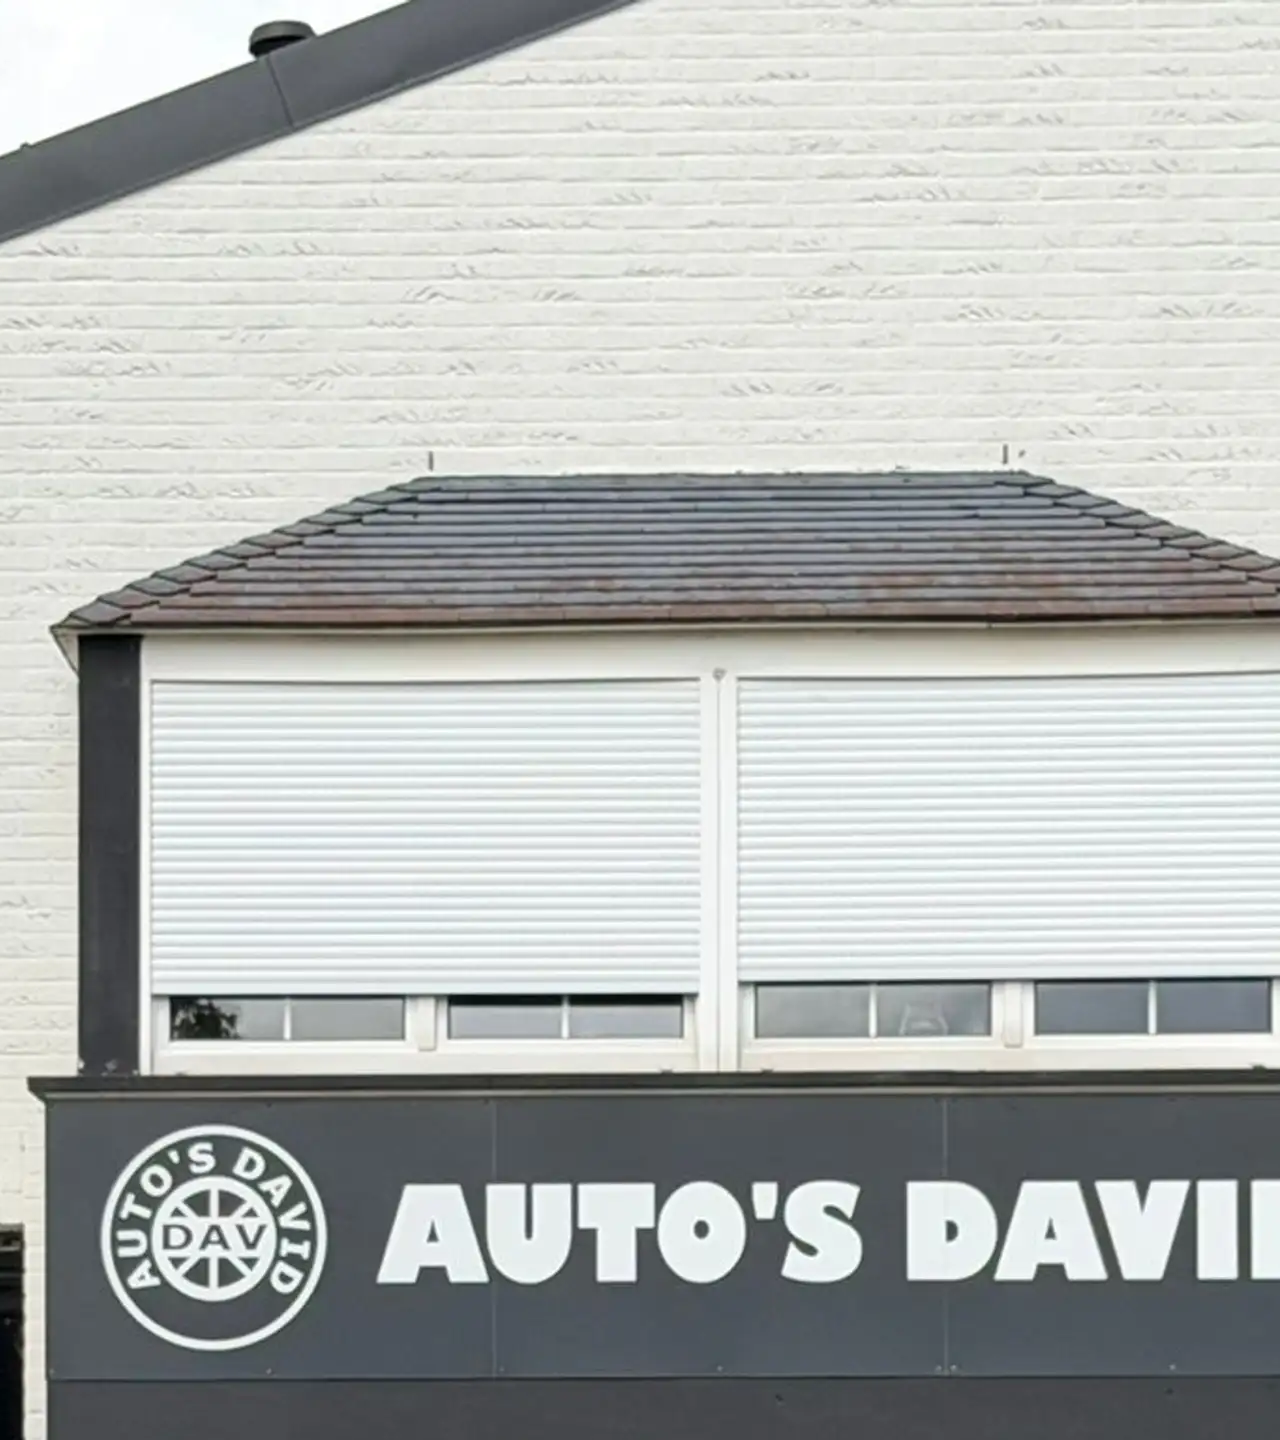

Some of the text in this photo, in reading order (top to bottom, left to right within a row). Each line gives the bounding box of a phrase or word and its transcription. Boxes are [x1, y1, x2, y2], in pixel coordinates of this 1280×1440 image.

[116, 1142, 312, 1294] AUTO'S DAVID
[162, 1223, 267, 1251] DAV
[376, 1180, 863, 1284] AUTO'S
